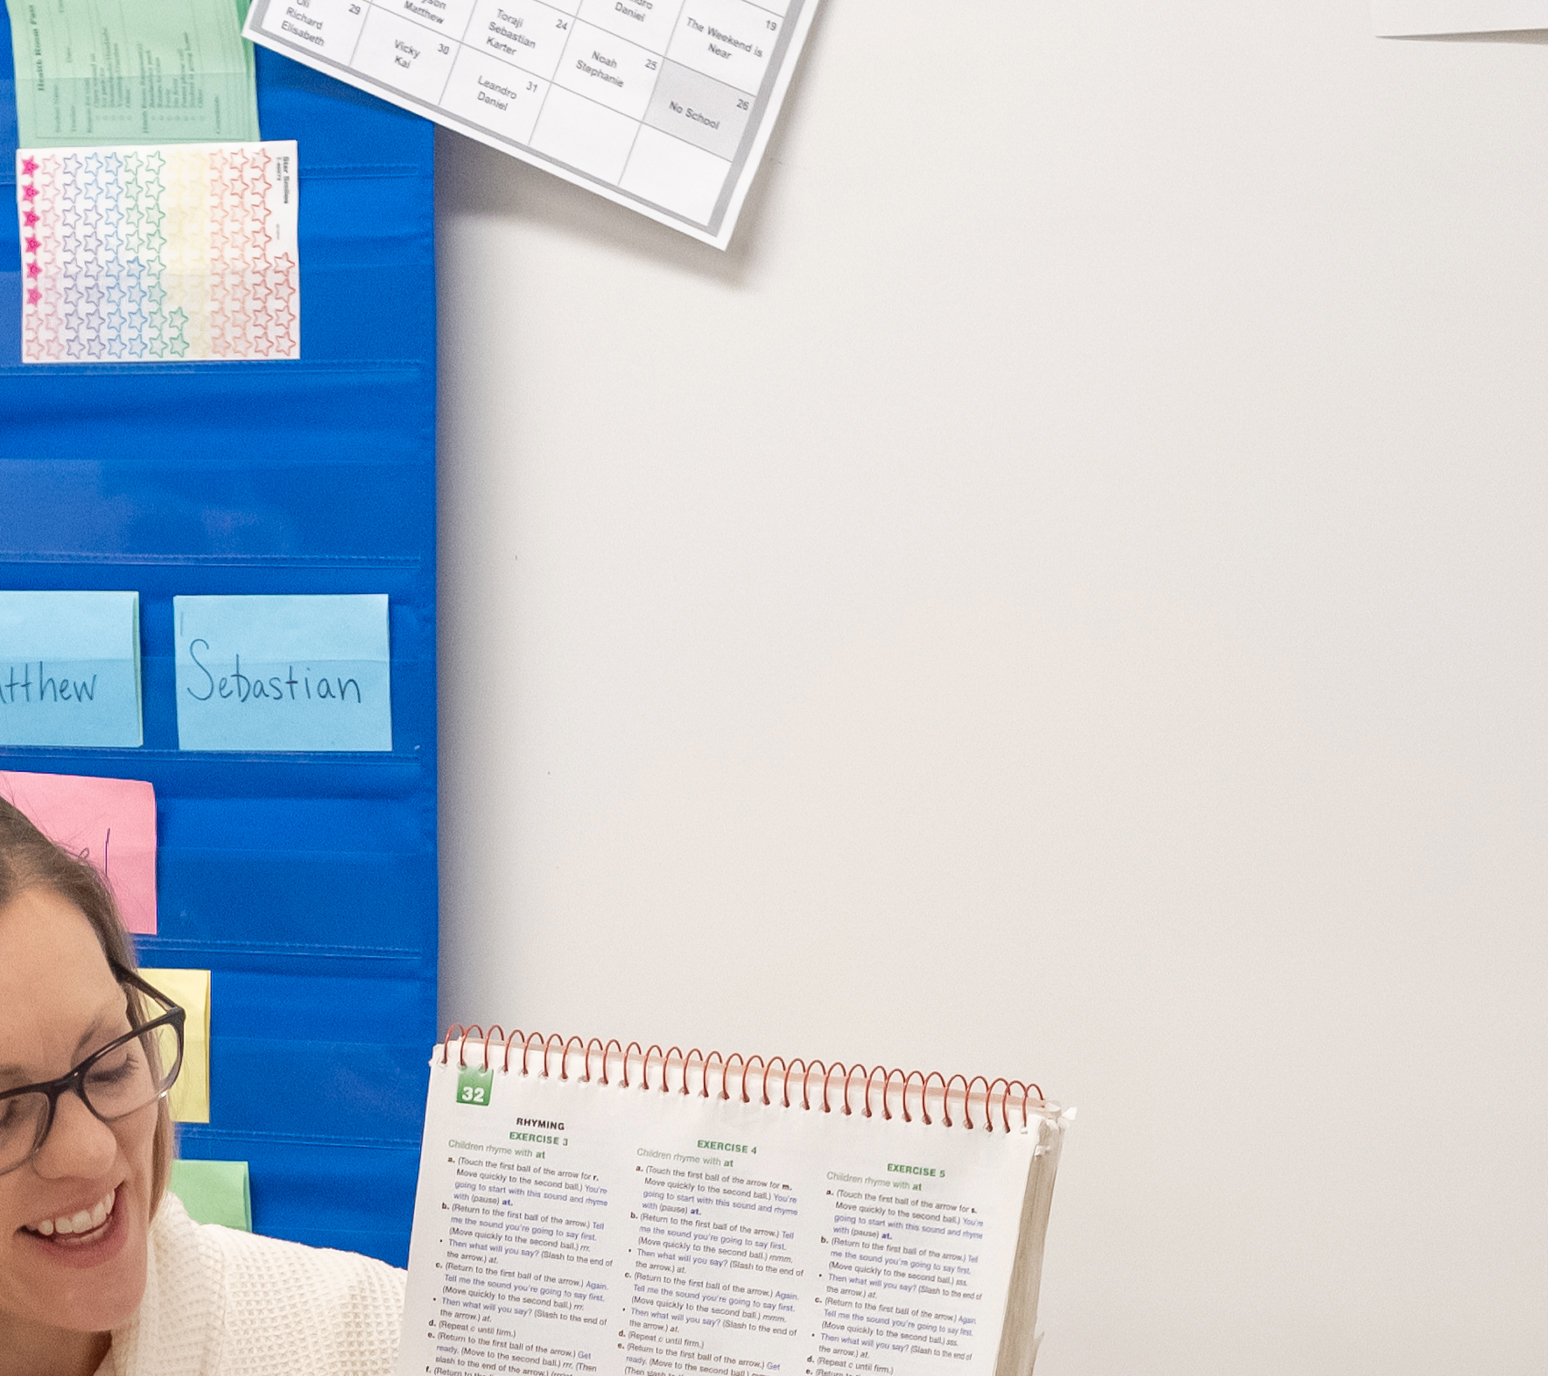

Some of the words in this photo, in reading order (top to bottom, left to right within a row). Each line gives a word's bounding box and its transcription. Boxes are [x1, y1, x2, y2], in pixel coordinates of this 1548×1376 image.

[286, 8, 323, 30] Richard
[348, 4, 361, 15] 29
[404, 2, 444, 25] Matthew
[497, 9, 524, 28] Toraji
[615, 1, 645, 23] Daniel
[281, 21, 325, 47] Elisabeth
[556, 19, 568, 31] 24
[765, 19, 777, 32] 19
[488, 21, 536, 49] Sebastian
[687, 17, 704, 33] The
[707, 25, 752, 54] Weekend
[754, 45, 763, 57] is
[394, 39, 420, 59] Vicky
[438, 43, 450, 55] 30
[486, 36, 517, 56] Karter
[394, 55, 411, 69] Kai
[591, 50, 617, 69] Noah
[645, 59, 657, 72] 25
[576, 59, 624, 89] Stephanie
[478, 75, 517, 100] Leandro
[526, 81, 538, 93] 31
[478, 91, 508, 111] Daniel
[737, 98, 749, 111] 26
[669, 100, 684, 114] No
[685, 108, 720, 130] School
[187, 638, 361, 704] Sebastian
[462, 1086, 485, 1102] 32
[516, 1118, 565, 1131] RHYMING
[509, 1131, 559, 1146] EXERCISE
[563, 1138, 568, 1146] 3
[697, 1139, 748, 1154] EXERCISE
[751, 1146, 757, 1154] 4
[449, 1139, 483, 1152] Children
[486, 1143, 512, 1155] rhyme
[515, 1148, 532, 1158] with
[536, 1151, 546, 1159] at
[887, 1163, 936, 1176] EXERCISE
